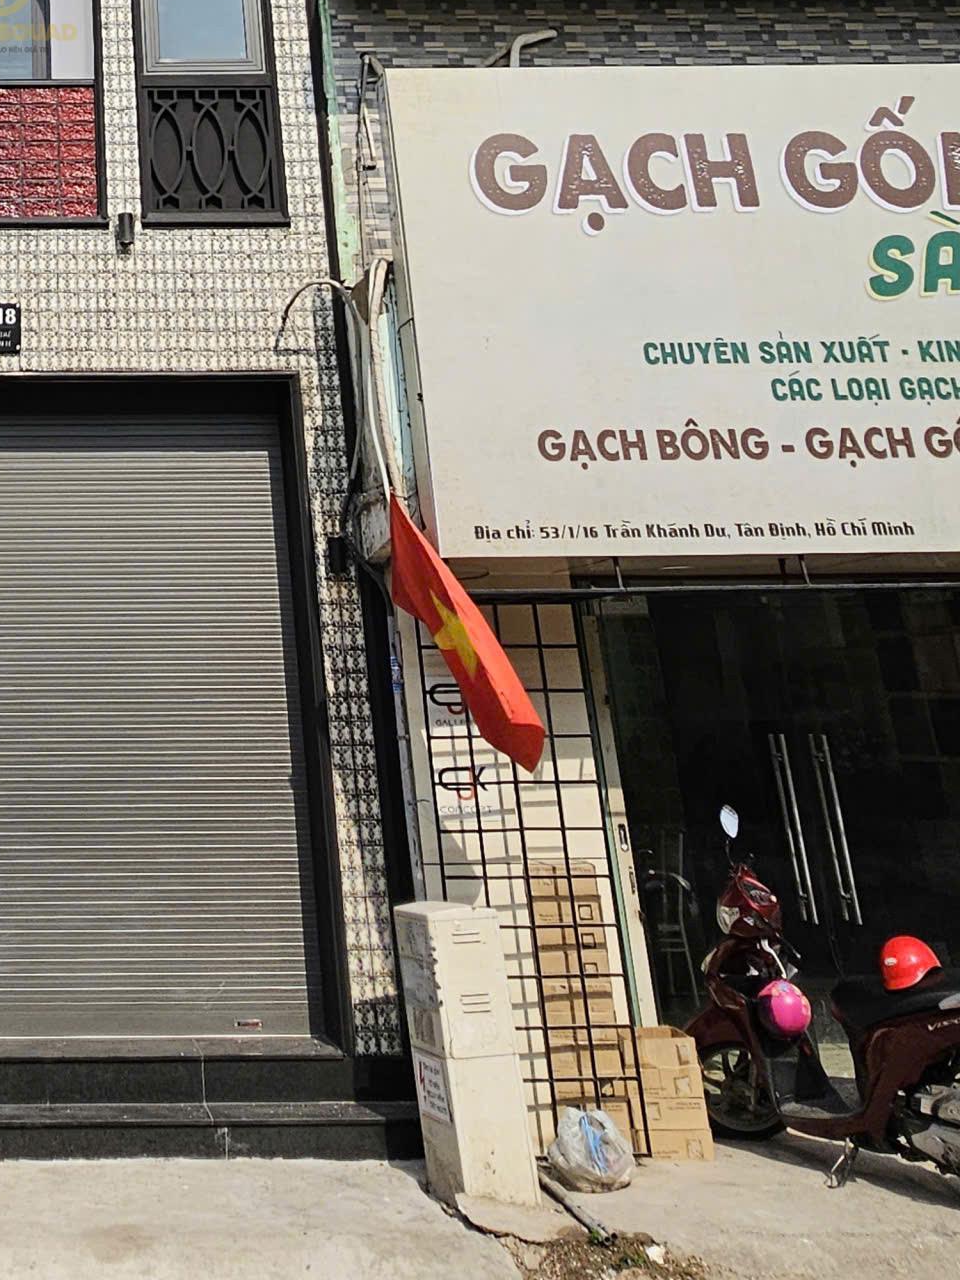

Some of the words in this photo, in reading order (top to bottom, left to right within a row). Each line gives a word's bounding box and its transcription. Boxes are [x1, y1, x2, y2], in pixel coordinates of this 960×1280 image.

[471, 132, 760, 235] GẠCH
[643, 337, 750, 365] CHUYÊN
[759, 331, 813, 364] SẢN
[820, 334, 890, 363] XUẤT
[771, 370, 823, 401] CÁC
[831, 377, 891, 406] LOẠI
[538, 428, 648, 470] GẠCH
[657, 418, 770, 461] BÔNG
[805, 426, 916, 469] GẠCH
[474, 525, 501, 544] Địa
[540, 524, 599, 540] 53/1/16
[735, 522, 765, 538] Tân
[872, 521, 915, 536] Minh
